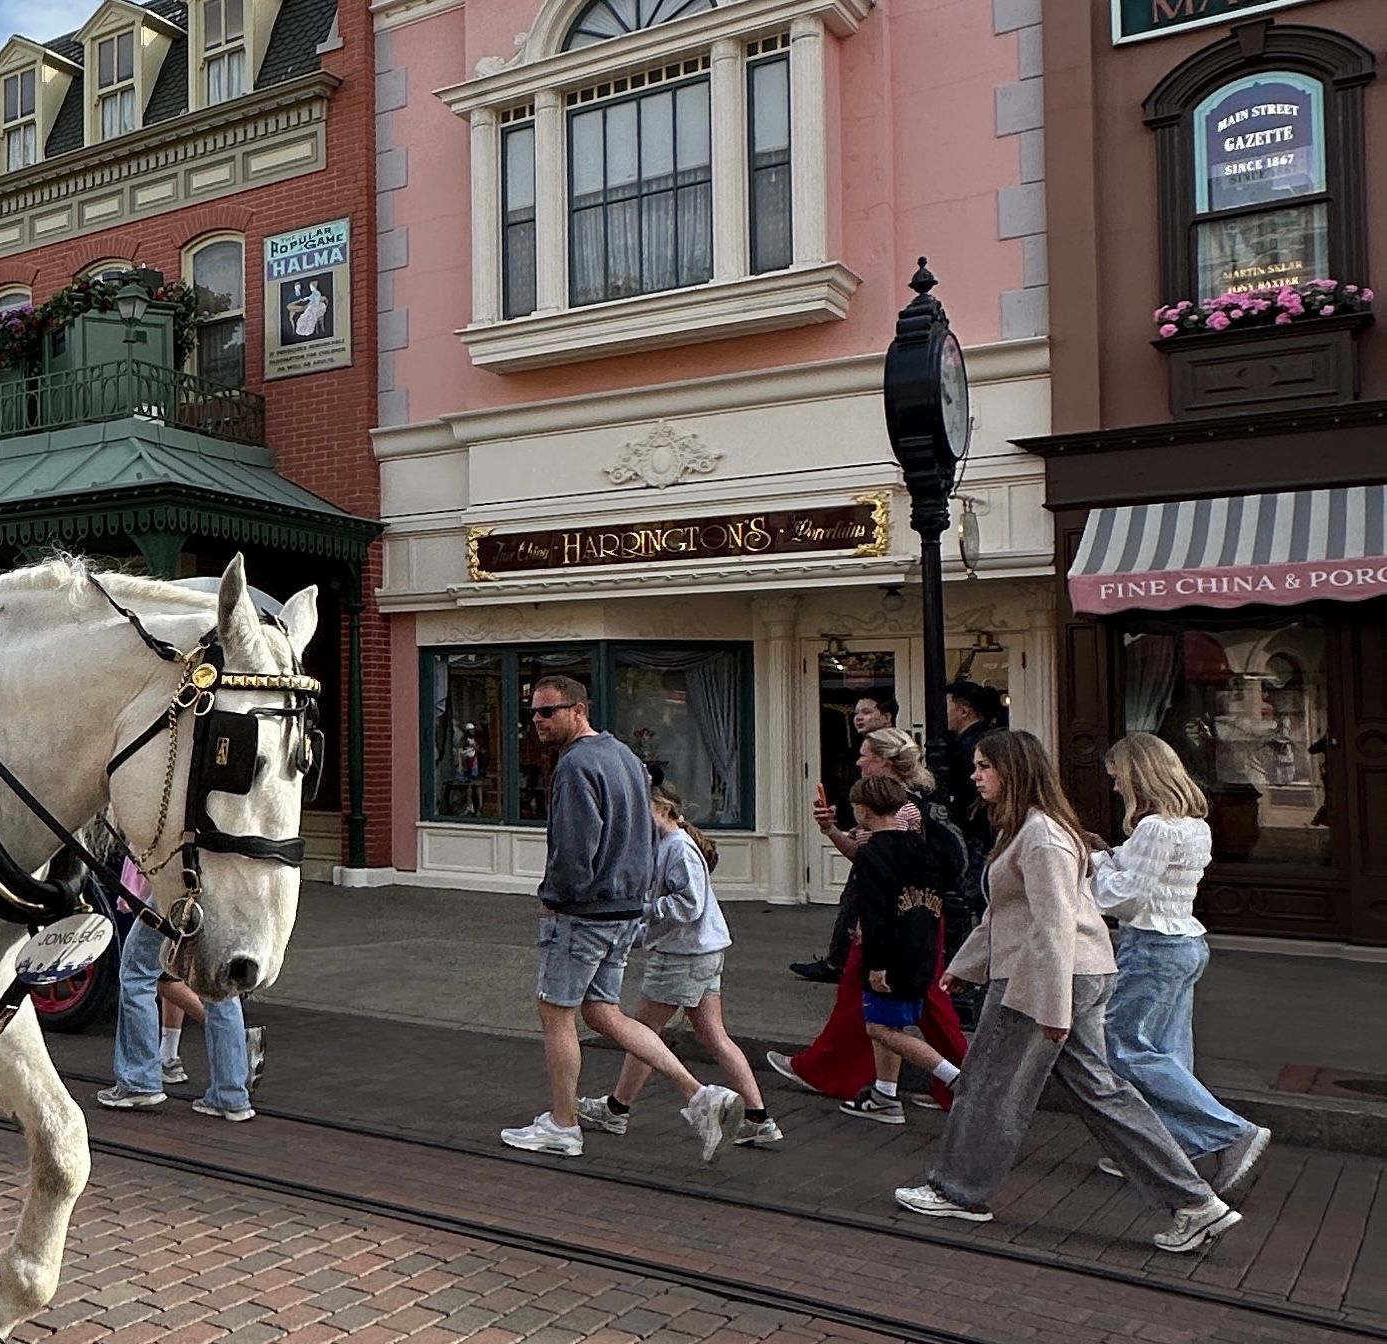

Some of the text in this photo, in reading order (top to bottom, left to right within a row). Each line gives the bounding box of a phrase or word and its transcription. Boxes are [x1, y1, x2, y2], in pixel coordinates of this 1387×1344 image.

[1217, 103, 1300, 132] MAIN STREET
[1224, 125, 1294, 152] GAZETTE
[1224, 153, 1295, 176] SINCE 1867
[270, 226, 332, 258] POPULAR
[303, 232, 344, 250] GAME
[270, 245, 344, 278] HALMA
[1222, 266, 1267, 279] MARTIN
[562, 517, 772, 565] HARRINGTON'S
[1099, 580, 1168, 600] FINE
[1175, 573, 1277, 595] CHINA
[1284, 573, 1302, 590] &
